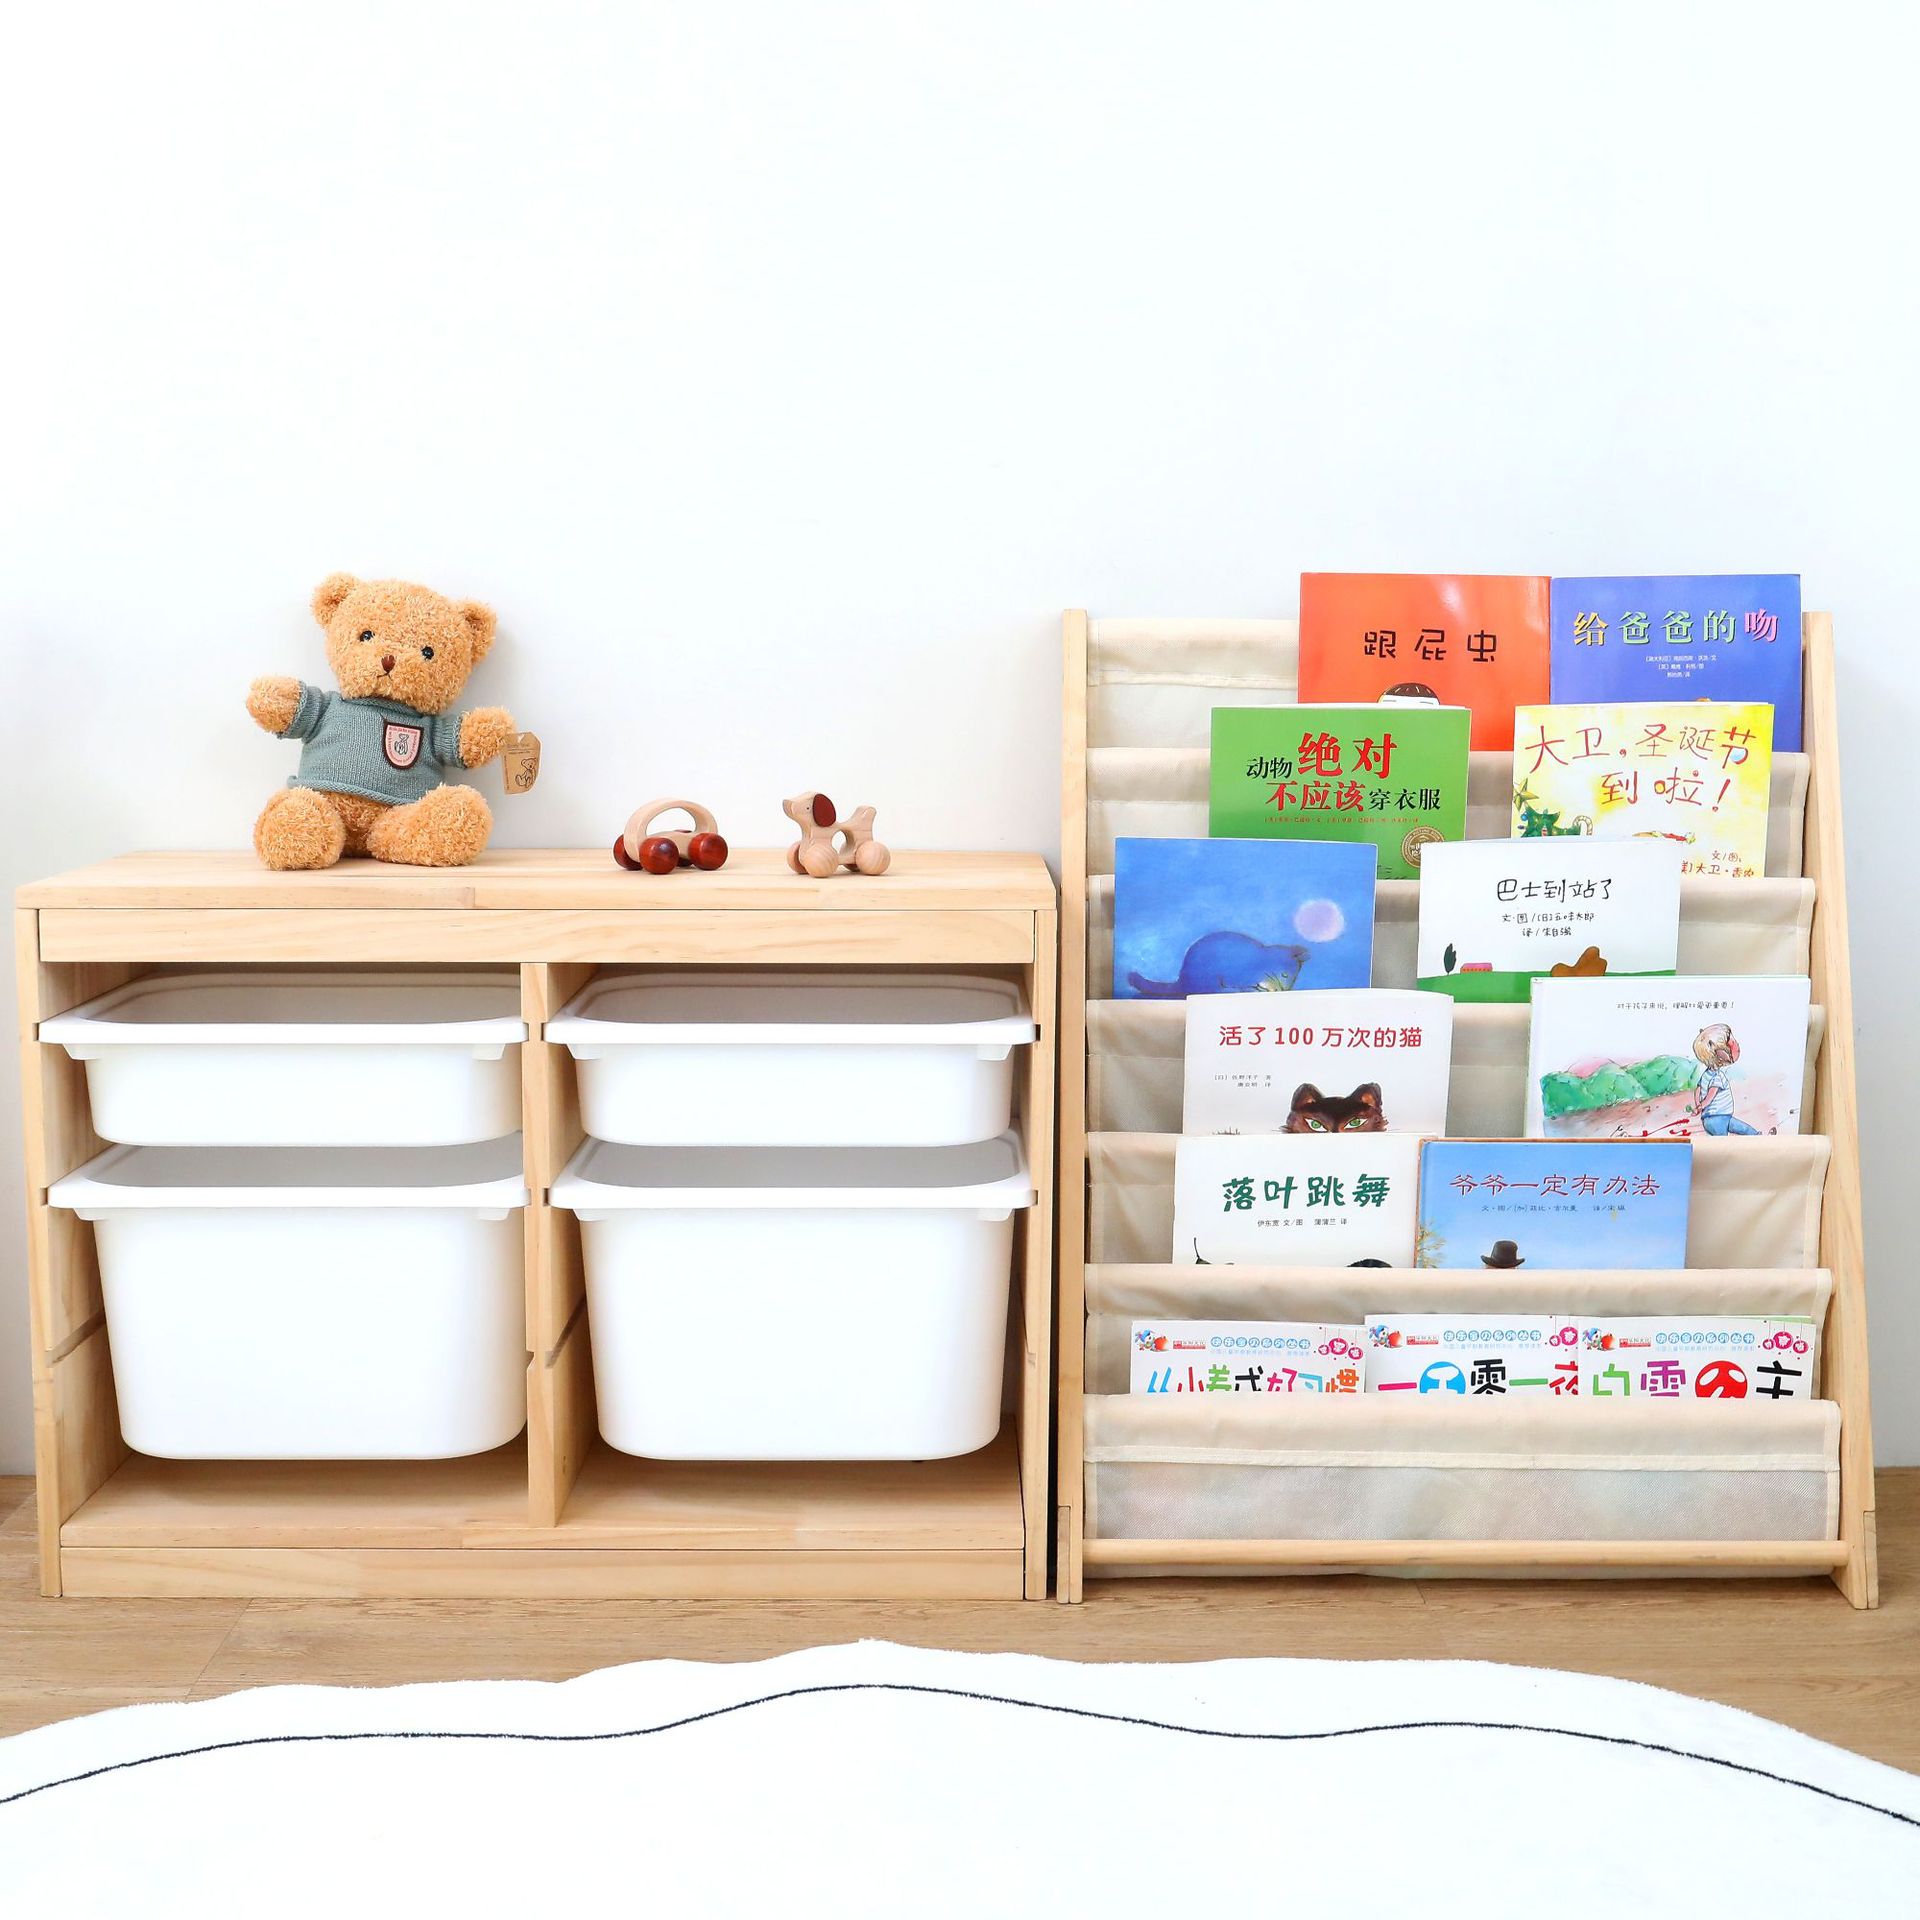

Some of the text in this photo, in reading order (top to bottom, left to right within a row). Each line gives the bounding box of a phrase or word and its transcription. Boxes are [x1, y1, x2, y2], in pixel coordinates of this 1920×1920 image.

[1573, 608, 1778, 646] 给爸爸的吻
[1364, 629, 1497, 662] 跟屁虫
[1497, 878, 1612, 903] 巴士到站了
[1222, 1173, 1391, 1212] 落叶跳舞
[1449, 1173, 1661, 1197] 爷爷一定有办法
